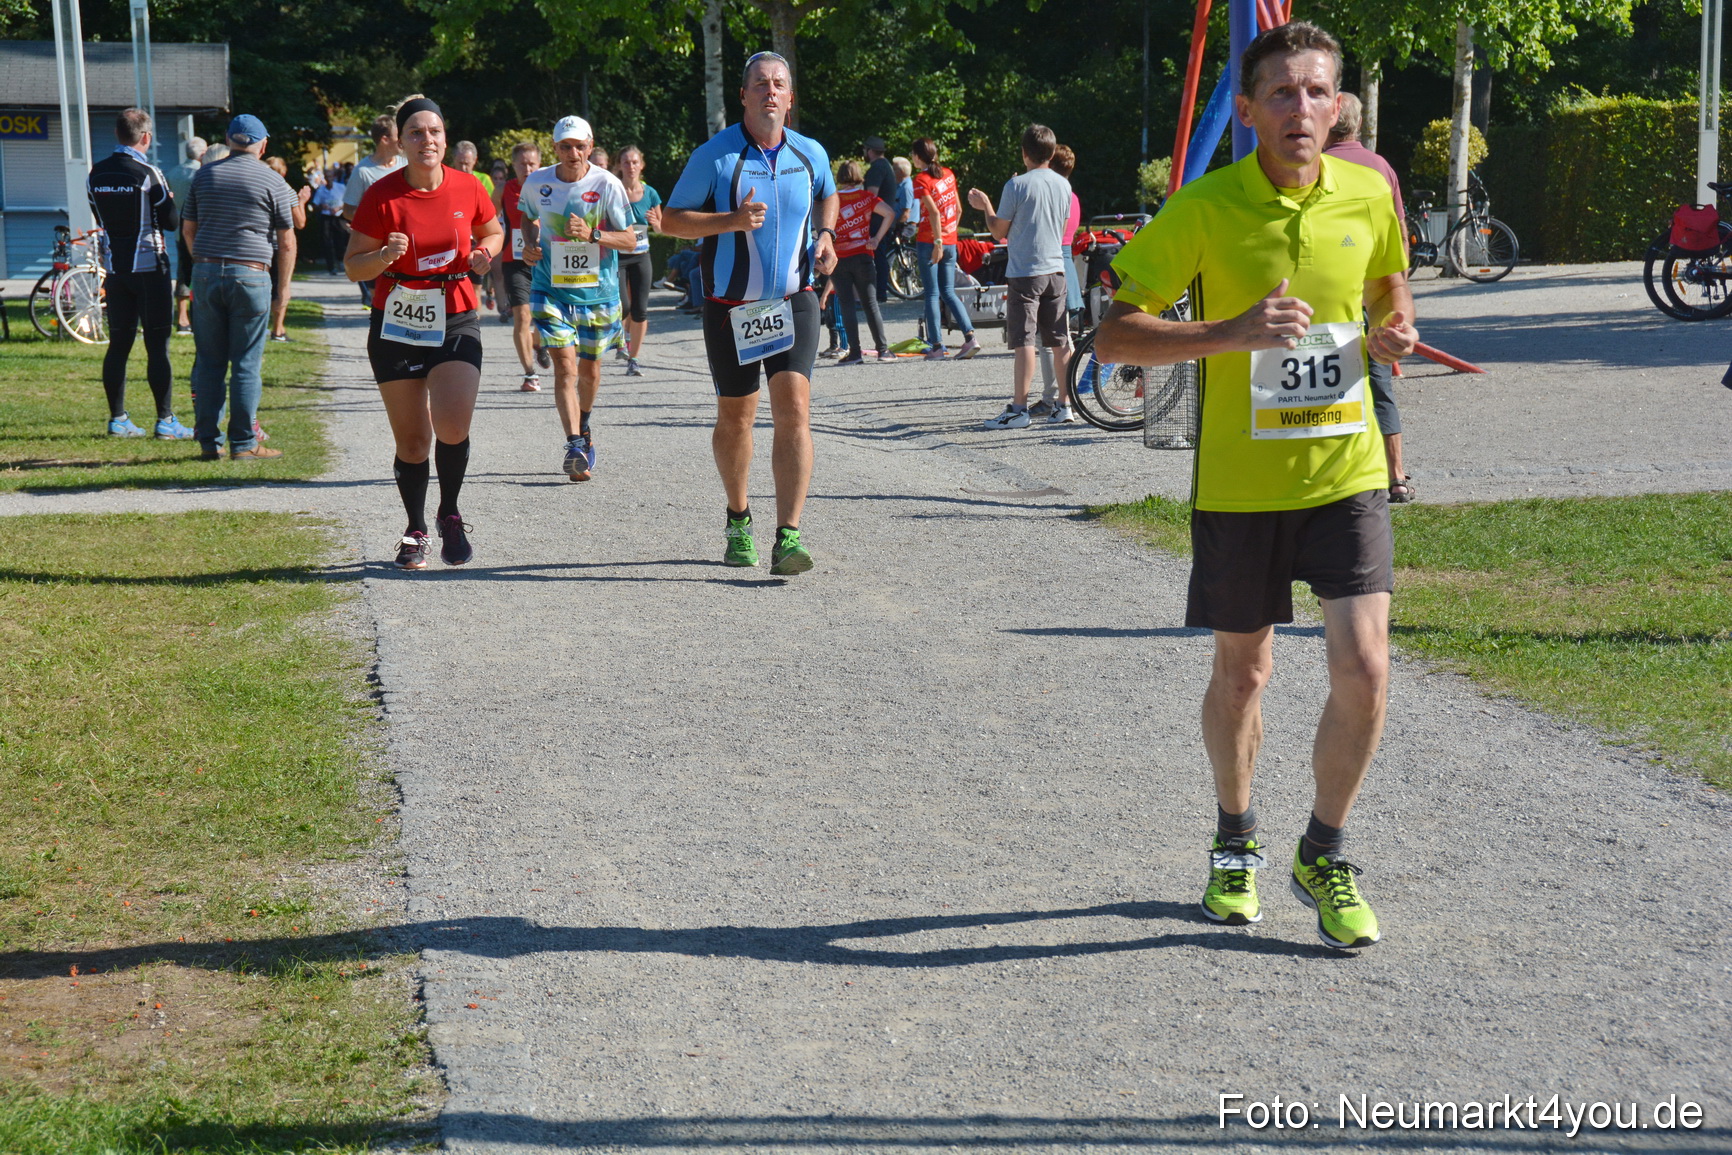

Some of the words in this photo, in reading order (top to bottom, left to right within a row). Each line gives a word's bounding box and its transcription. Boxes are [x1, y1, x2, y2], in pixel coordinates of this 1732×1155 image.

[563, 255, 589, 269] 182
[393, 301, 436, 323] 2445
[741, 314, 784, 339] 2345
[404, 329, 421, 340] Anja
[761, 344, 774, 353] Jim
[1280, 354, 1342, 391] 315
[1278, 395, 1303, 403] PARTL
[1304, 393, 1336, 402] Neumarkt
[1279, 410, 1342, 426] Wolfgang
